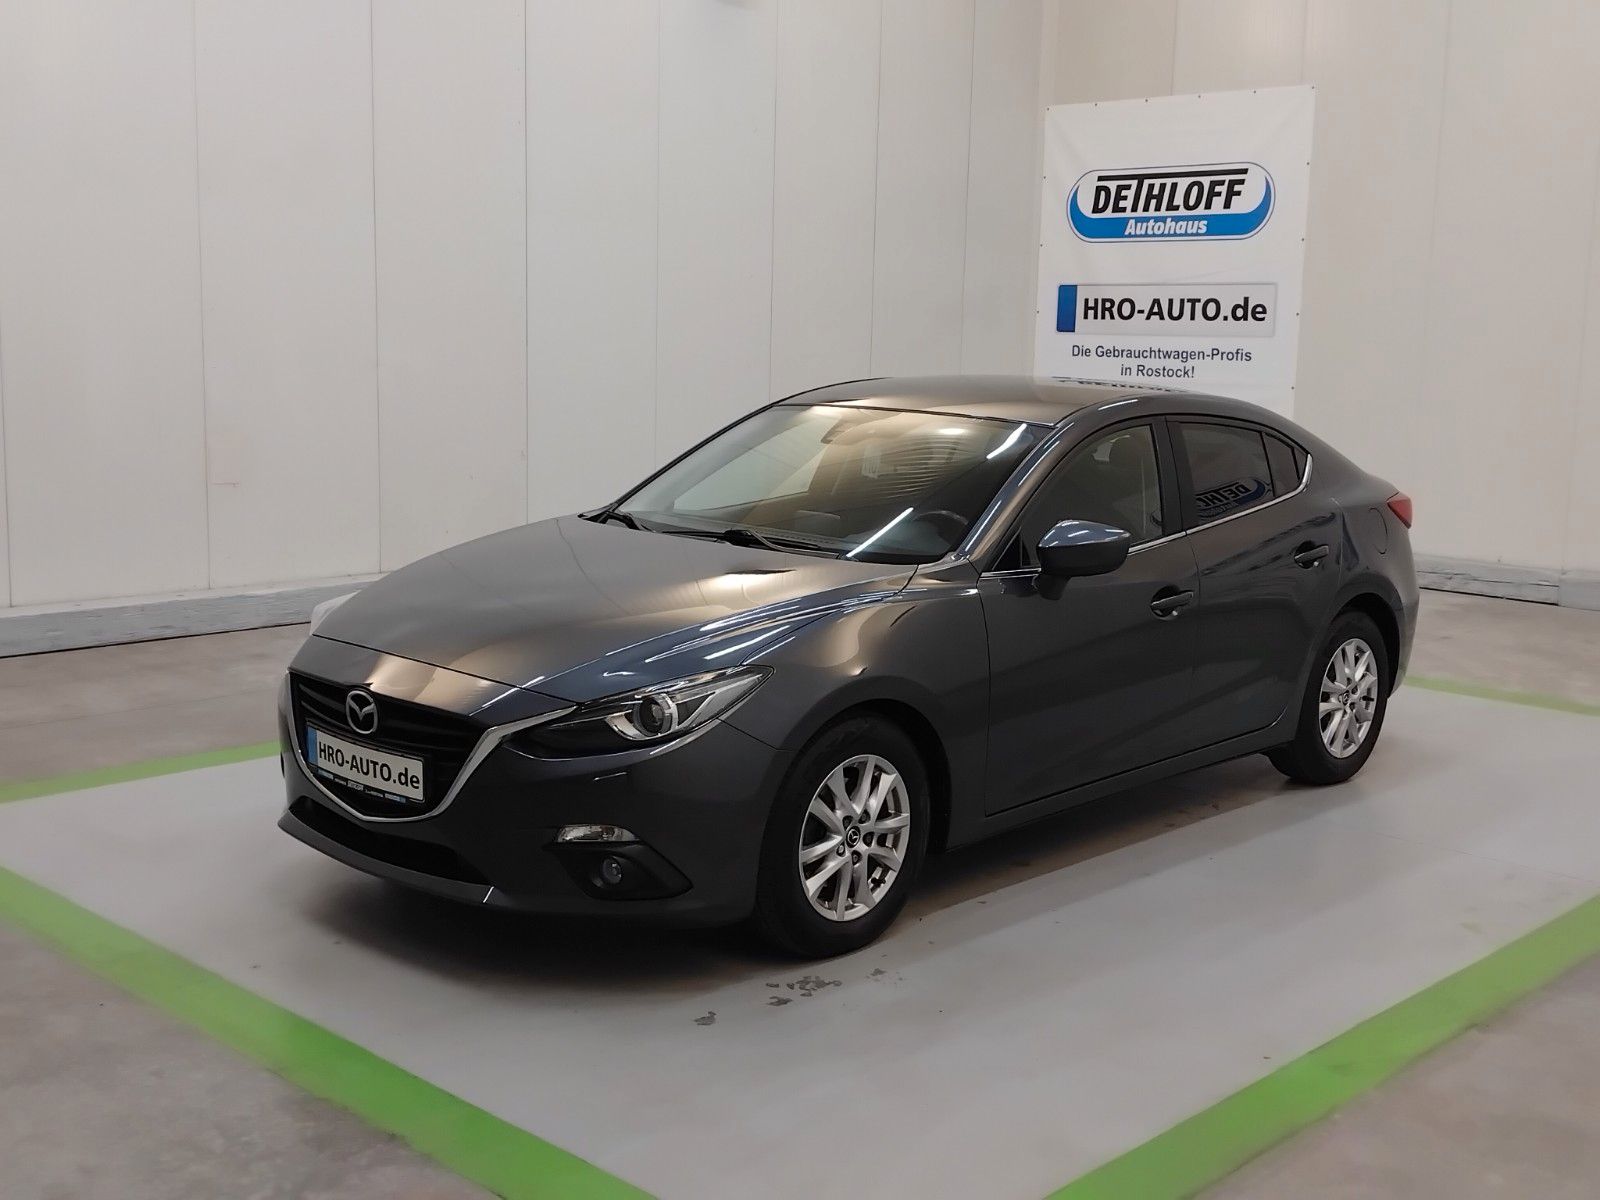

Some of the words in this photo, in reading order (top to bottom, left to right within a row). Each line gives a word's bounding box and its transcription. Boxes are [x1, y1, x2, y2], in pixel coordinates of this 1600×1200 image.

[1091, 168, 1249, 214] DETHLOFF
[1124, 217, 1208, 236] Autohaus
[1082, 297, 1268, 322] HRO-AUTO.de
[1071, 345, 1092, 358] Die
[1095, 345, 1252, 363] Gebrauchtwagen-Profis
[1120, 364, 1132, 376] in
[1136, 364, 1195, 378] Rostock!
[319, 742, 420, 789] HRO-AUTO.de
